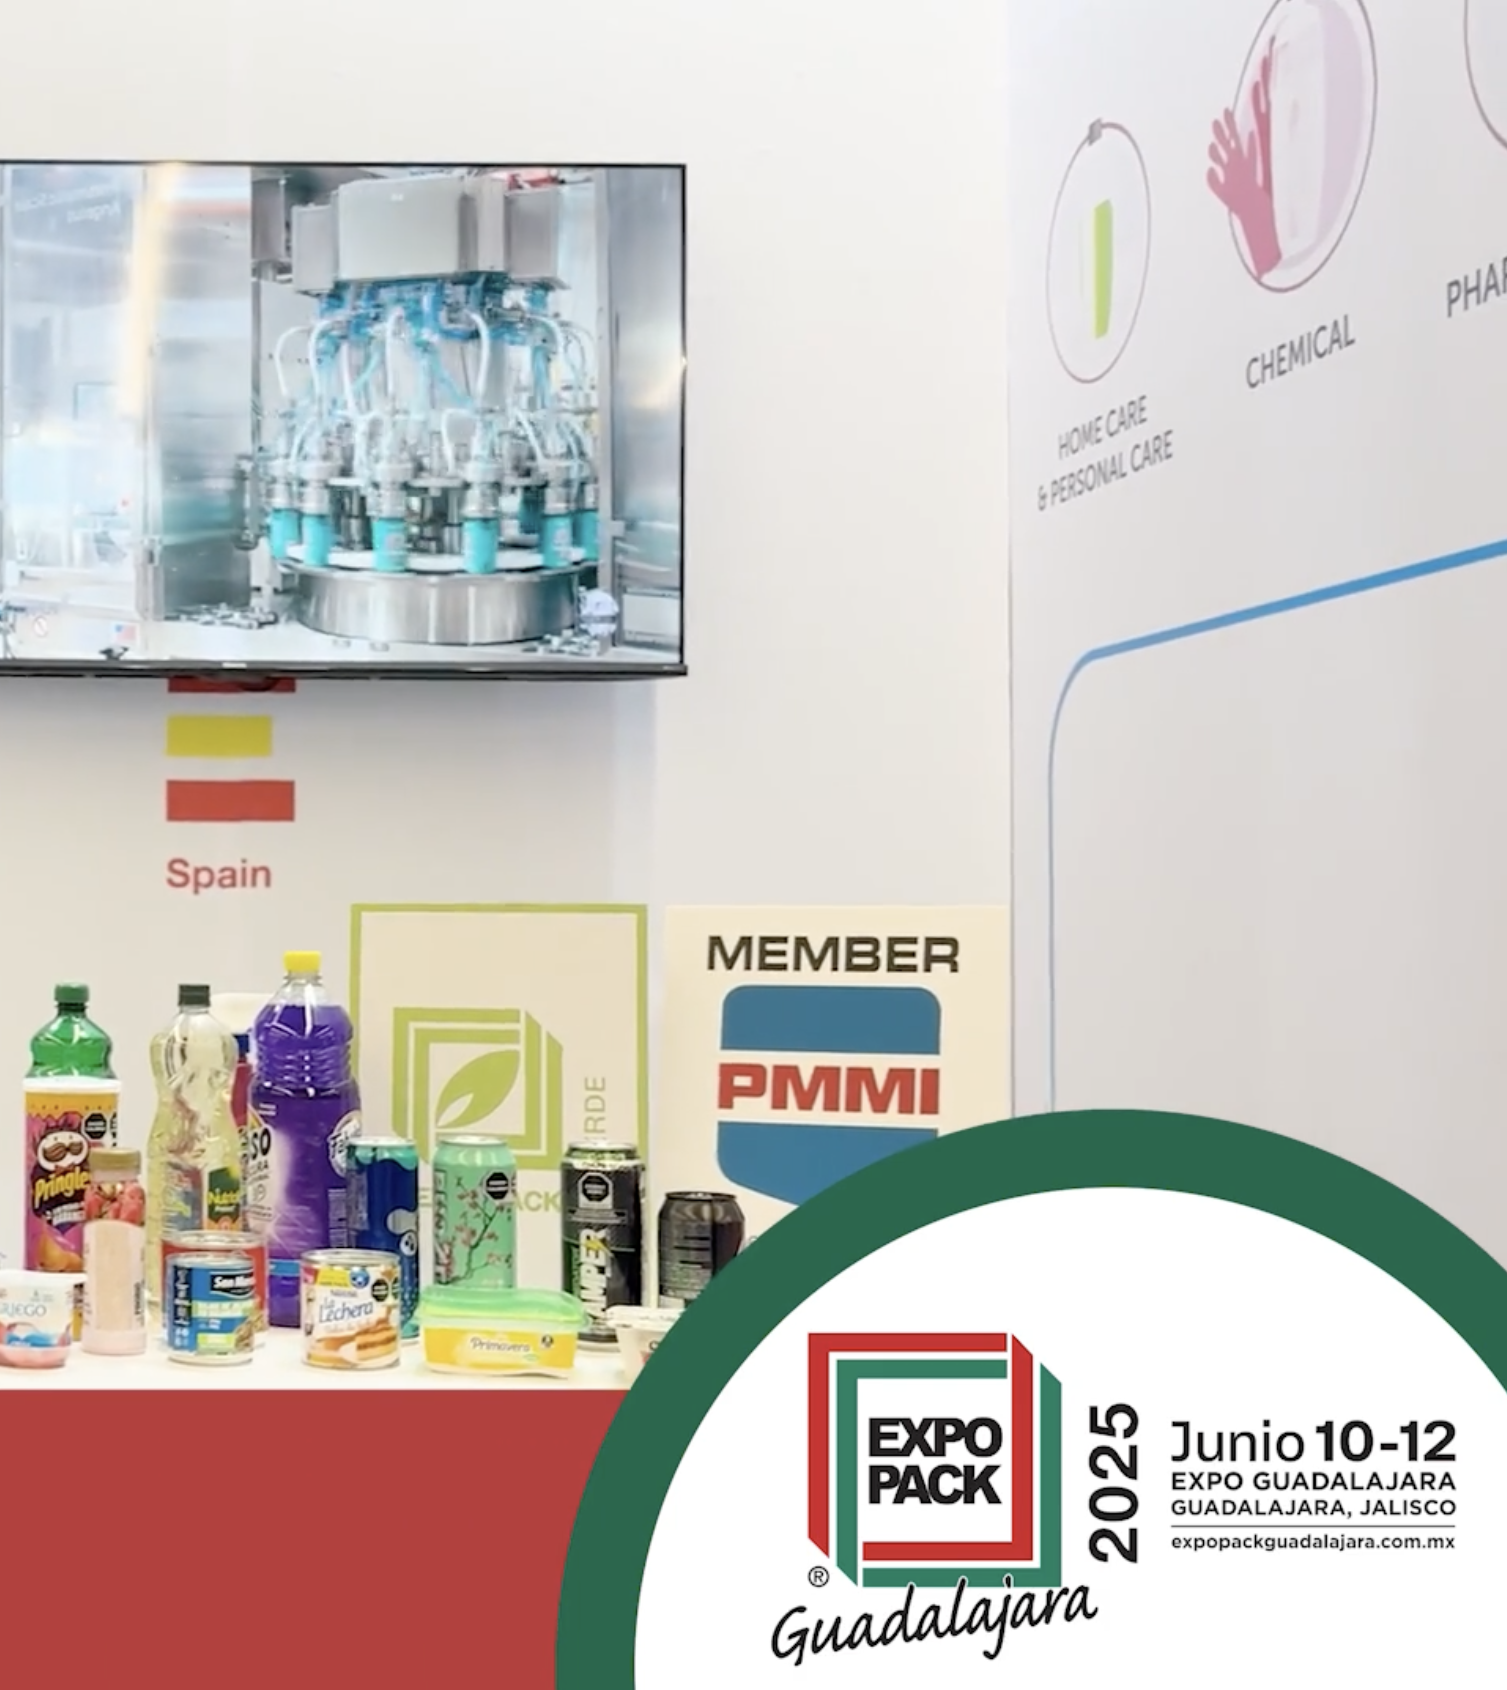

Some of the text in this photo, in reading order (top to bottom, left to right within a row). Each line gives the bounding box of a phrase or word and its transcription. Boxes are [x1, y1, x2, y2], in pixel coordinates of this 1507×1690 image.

[1246, 314, 1356, 389] CHEMICAL
[1058, 395, 1148, 460] HOME CARE
[1038, 429, 1173, 511] & PERSONAL CARE
[166, 858, 272, 895] Spain
[707, 935, 960, 973] MEMBER
[584, 1077, 606, 1141] RDE
[717, 1062, 940, 1115] PMMI
[34, 1166, 92, 1210] Pringle
[319, 1301, 373, 1323] Lechera
[470, 1336, 530, 1352] Primavera
